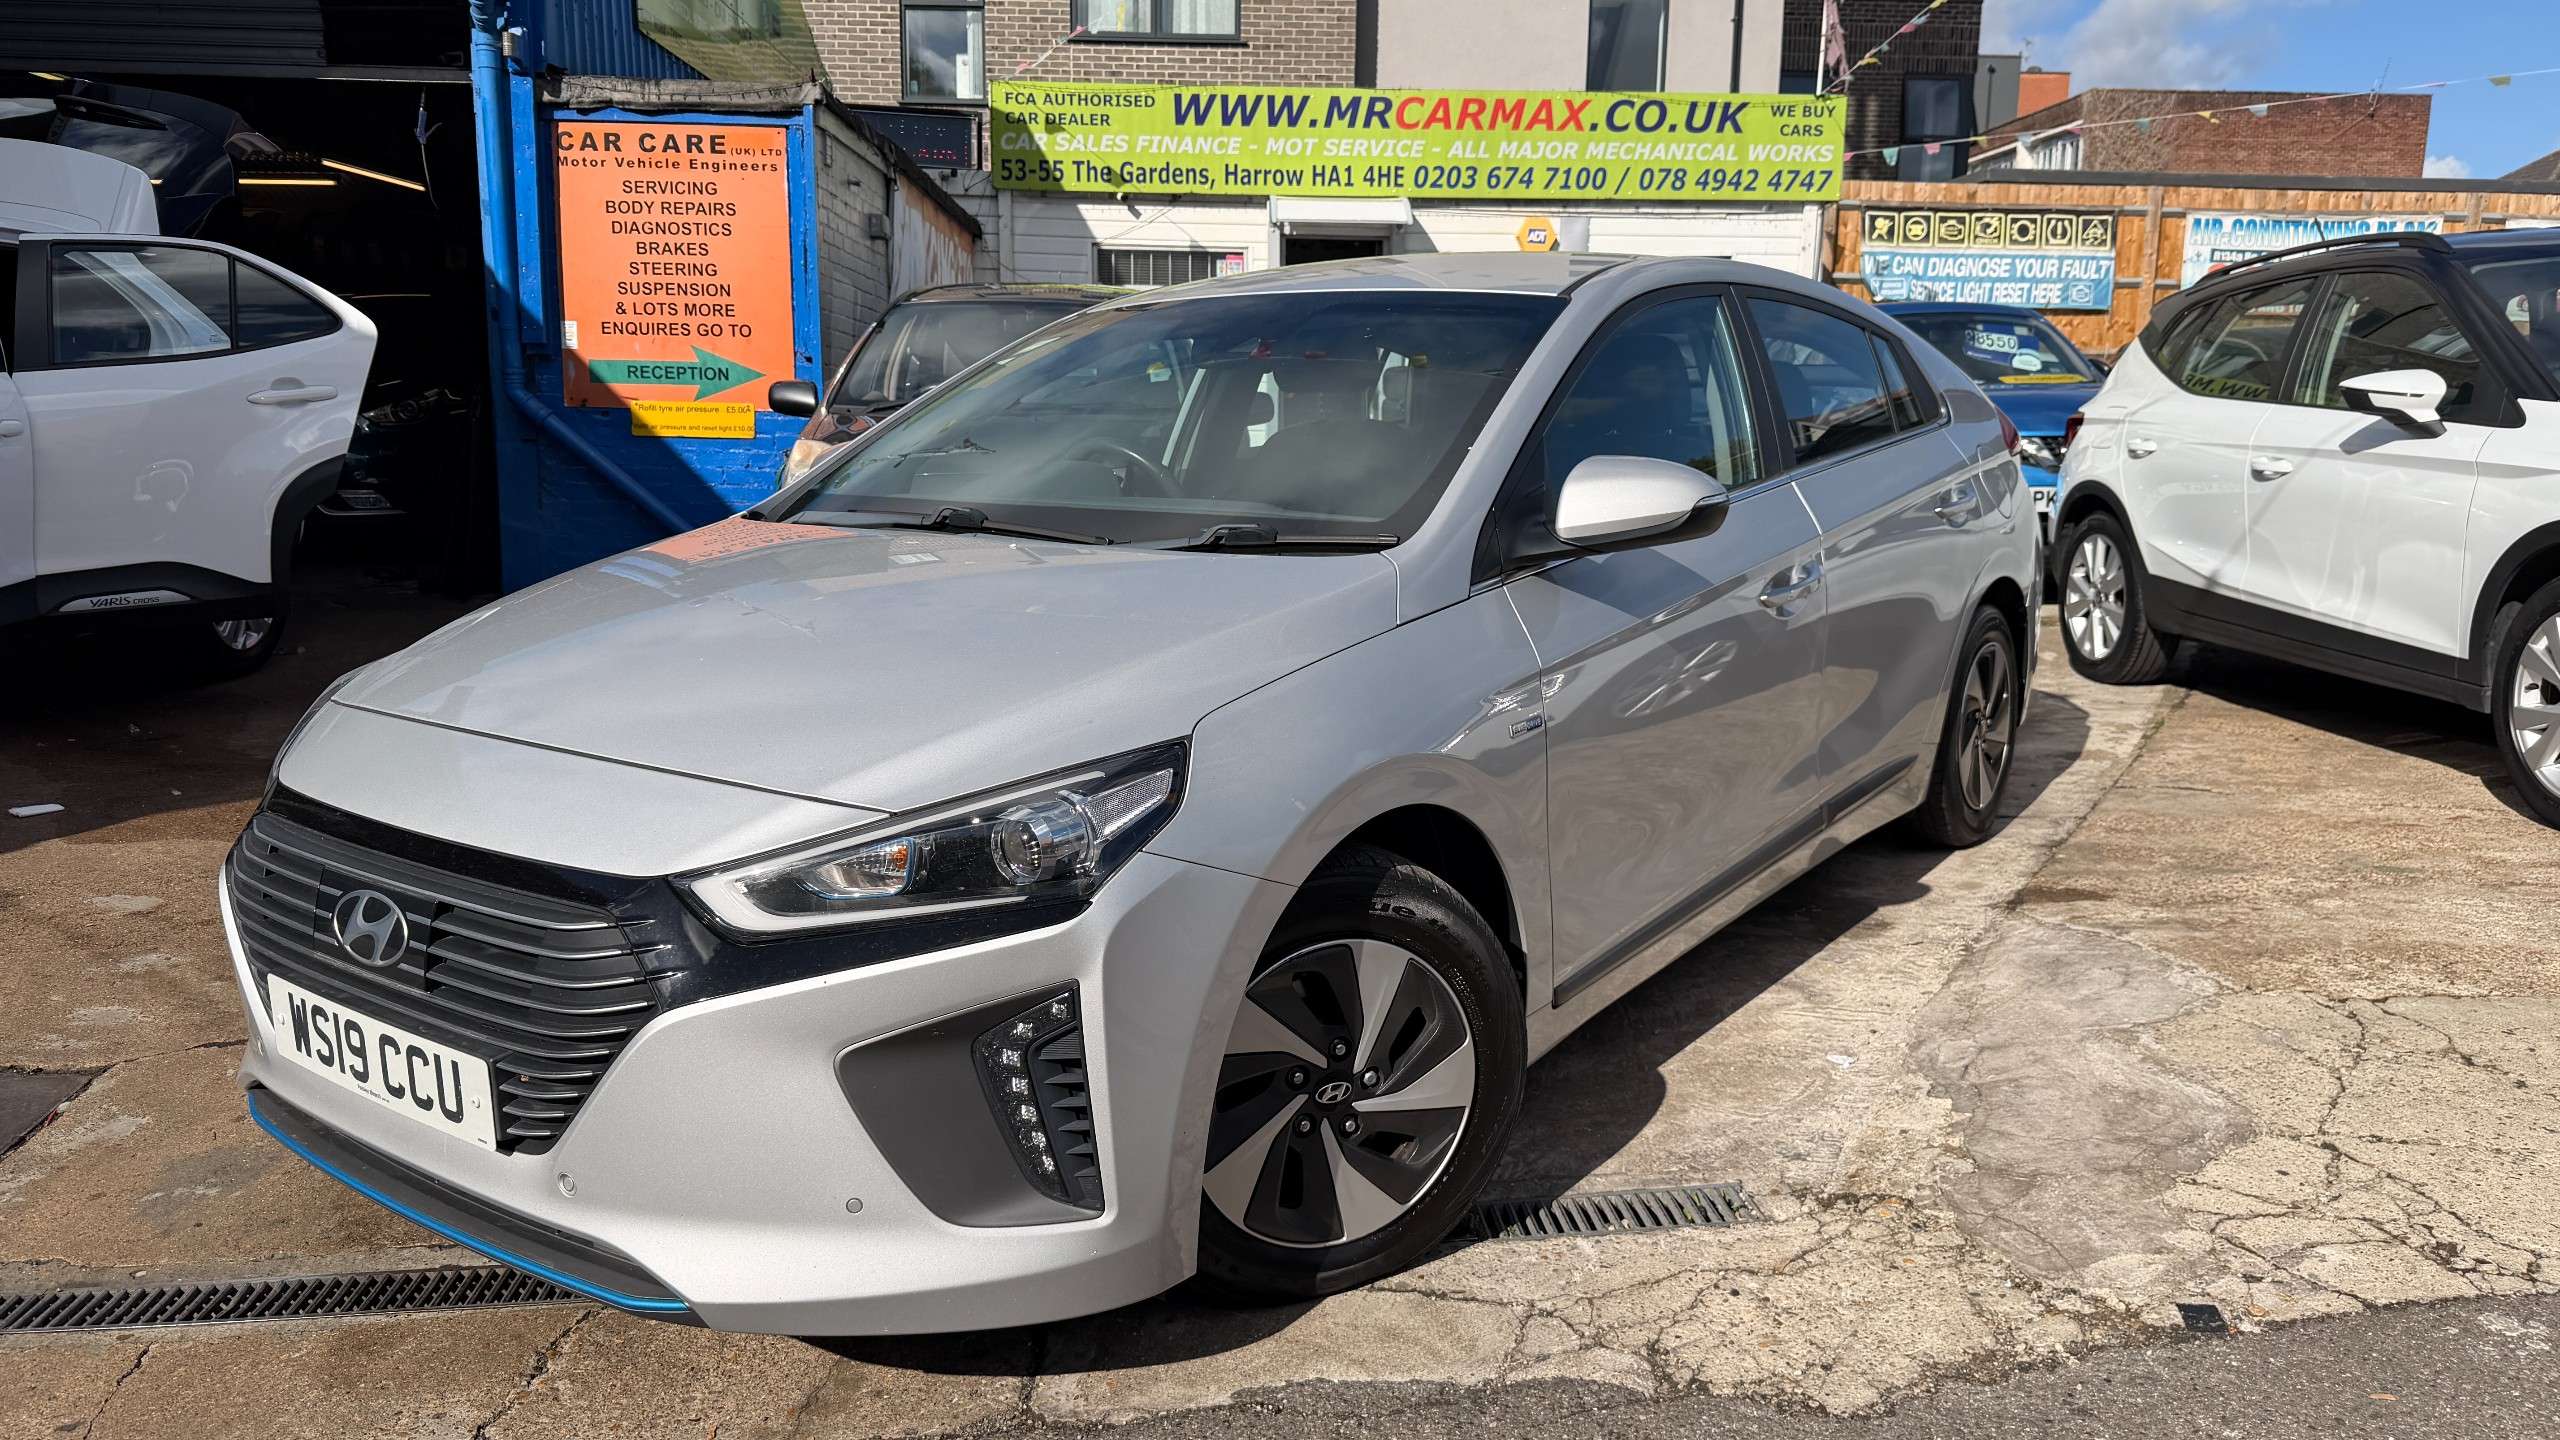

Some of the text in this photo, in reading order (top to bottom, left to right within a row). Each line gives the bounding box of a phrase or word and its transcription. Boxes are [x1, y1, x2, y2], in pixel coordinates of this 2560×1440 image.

[1005, 92, 1155, 108] FCA AUTHORISED
[1005, 112, 1111, 126] CAR DEALER
[1174, 93, 1749, 134] WWW.MRCARMAX.CO.UK
[1771, 104, 1836, 118] WE BUY
[1780, 124, 1823, 137] CARS
[558, 130, 782, 157] CAR CARE (UK) LTD
[1001, 133, 1047, 151] CAR
[1054, 134, 1129, 153] SALES
[1136, 135, 1241, 155] FINANCE
[1265, 137, 1318, 156] MOT
[1323, 138, 1425, 158] SERVICE
[1447, 141, 1490, 159] ALL
[1498, 141, 1579, 160] MAJOR
[1585, 142, 1738, 161] MECHANICAL
[1748, 144, 1834, 162] WORKS
[557, 156, 778, 173] Motor Vehicle Engineers
[1001, 159, 1833, 195] 53-55 The Gardens, Harrow HA1 4HE 0203 674 7100 / 078 4942 4747
[622, 180, 718, 196] SERVICING
[605, 200, 737, 217] BODY REPAIRS
[611, 221, 732, 237] DIAGNOSTICS
[636, 241, 709, 257] BRAKES
[629, 261, 718, 277] STEERING
[1864, 254, 2110, 280] WE CAN DIAGNOSE YOUR FAULT
[617, 281, 731, 297] SUSPENSION
[1910, 280, 1956, 303] SERVICE
[1956, 281, 1992, 303] LIGHT
[1991, 282, 2029, 304] RESET
[2031, 283, 2063, 304] HERE
[615, 302, 736, 318] & LOTS MORE
[601, 321, 752, 338] ENQUIRES GO TO
[627, 365, 730, 381] RECEPTION
[675, 405, 685, 413] air
[686, 406, 720, 416] pressure
[91, 597, 160, 607] YARIS CROSS
[288, 991, 464, 1124] WS19 CCU
